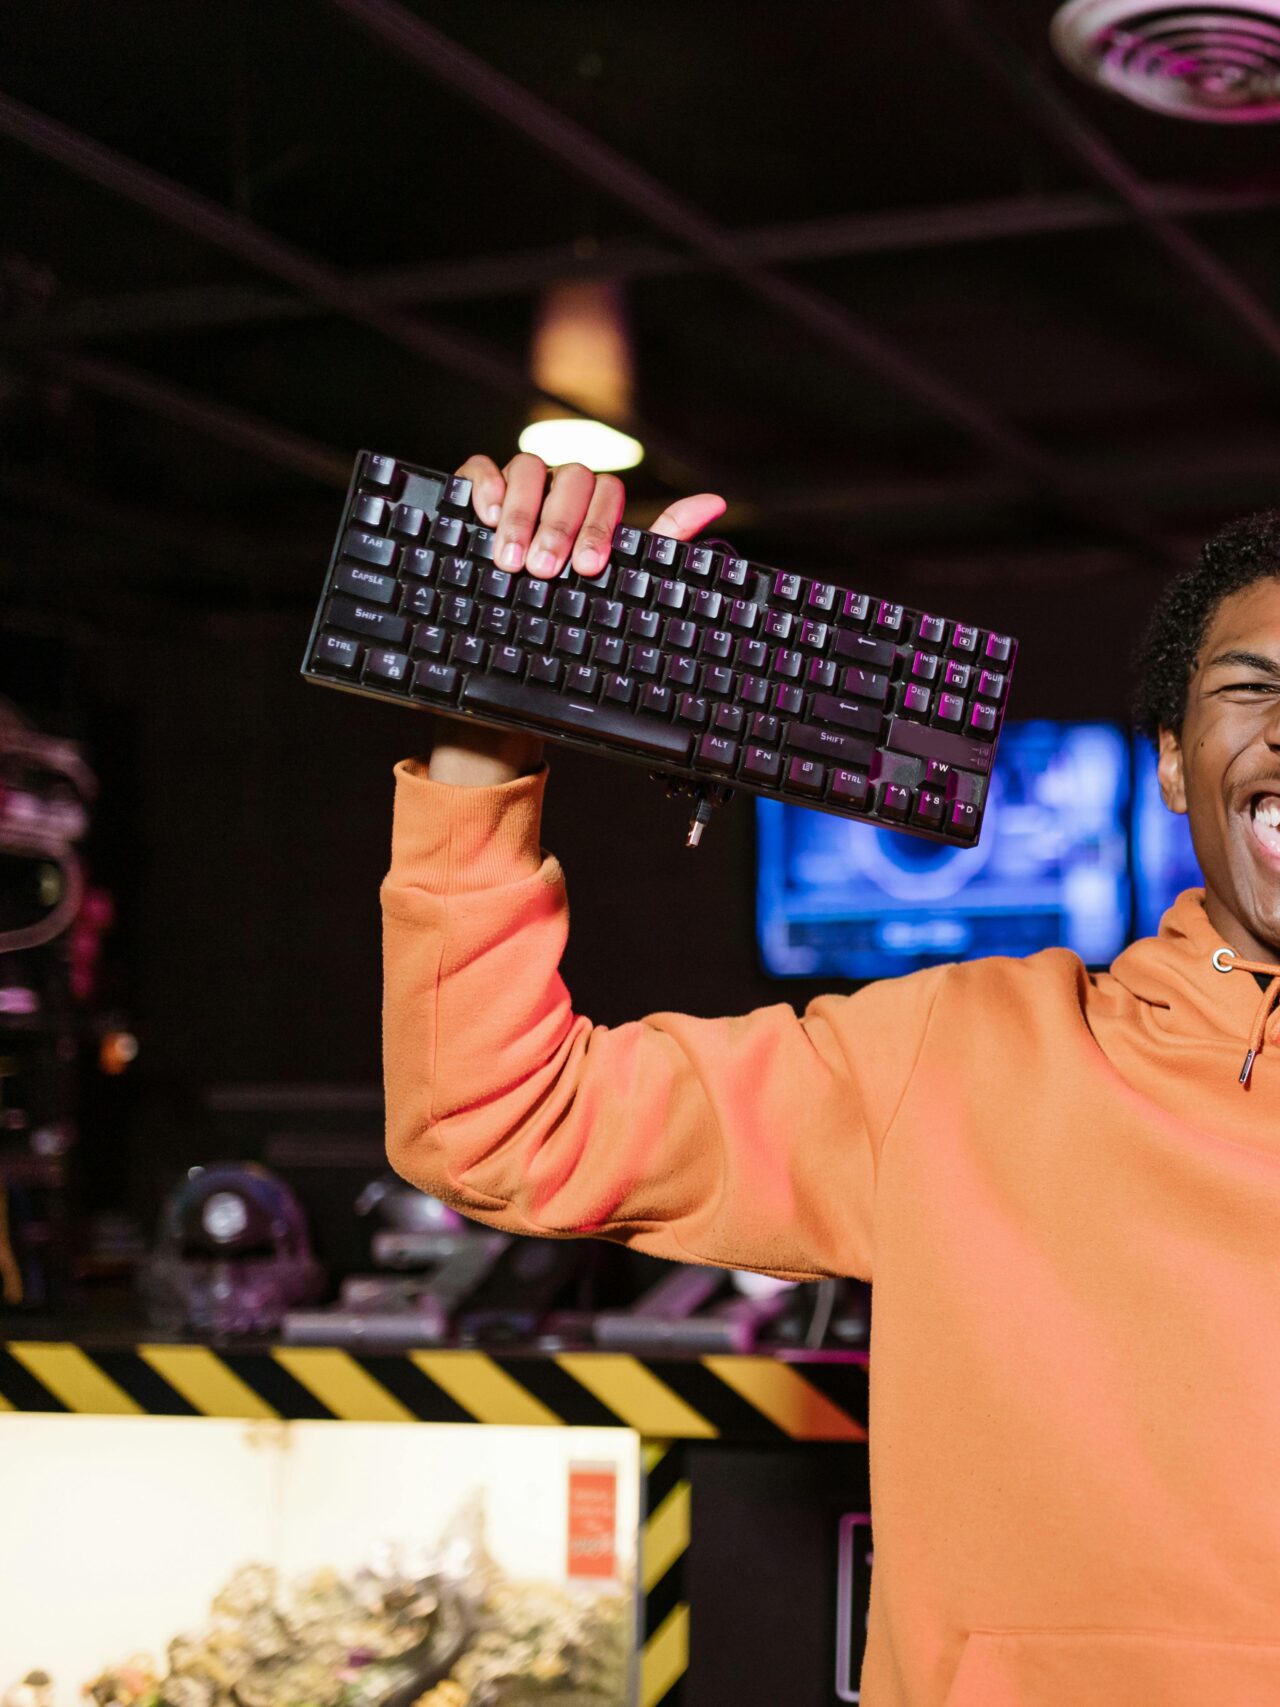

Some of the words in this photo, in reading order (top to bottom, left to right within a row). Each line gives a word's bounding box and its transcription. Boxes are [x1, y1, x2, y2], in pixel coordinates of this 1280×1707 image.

[621, 527, 636, 538] F5
[657, 538, 671, 548] F6
[415, 548, 427, 559] Q
[693, 548, 706, 558] F7
[454, 558, 467, 569] W
[729, 558, 743, 568] F8
[491, 571, 504, 580] E
[782, 573, 795, 583] F9
[529, 580, 540, 590] R
[415, 588, 427, 598] A
[568, 590, 580, 600] T
[454, 597, 467, 608] S
[606, 601, 617, 610] Y
[492, 607, 505, 617] D
[883, 603, 900, 614] F12
[641, 611, 652, 621] U
[530, 617, 543, 626] F
[425, 626, 440, 637] Z
[567, 627, 580, 638] G
[713, 632, 725, 641] O
[464, 636, 477, 648] X
[605, 637, 618, 648] H
[749, 641, 760, 649] P
[503, 647, 516, 657] C
[542, 656, 554, 666] V
[679, 658, 689, 668] K
[579, 666, 591, 677] B
[714, 667, 725, 677] L
[616, 676, 629, 687] N
[652, 686, 665, 696] M
[939, 763, 948, 772] W
[933, 797, 940, 805] S
